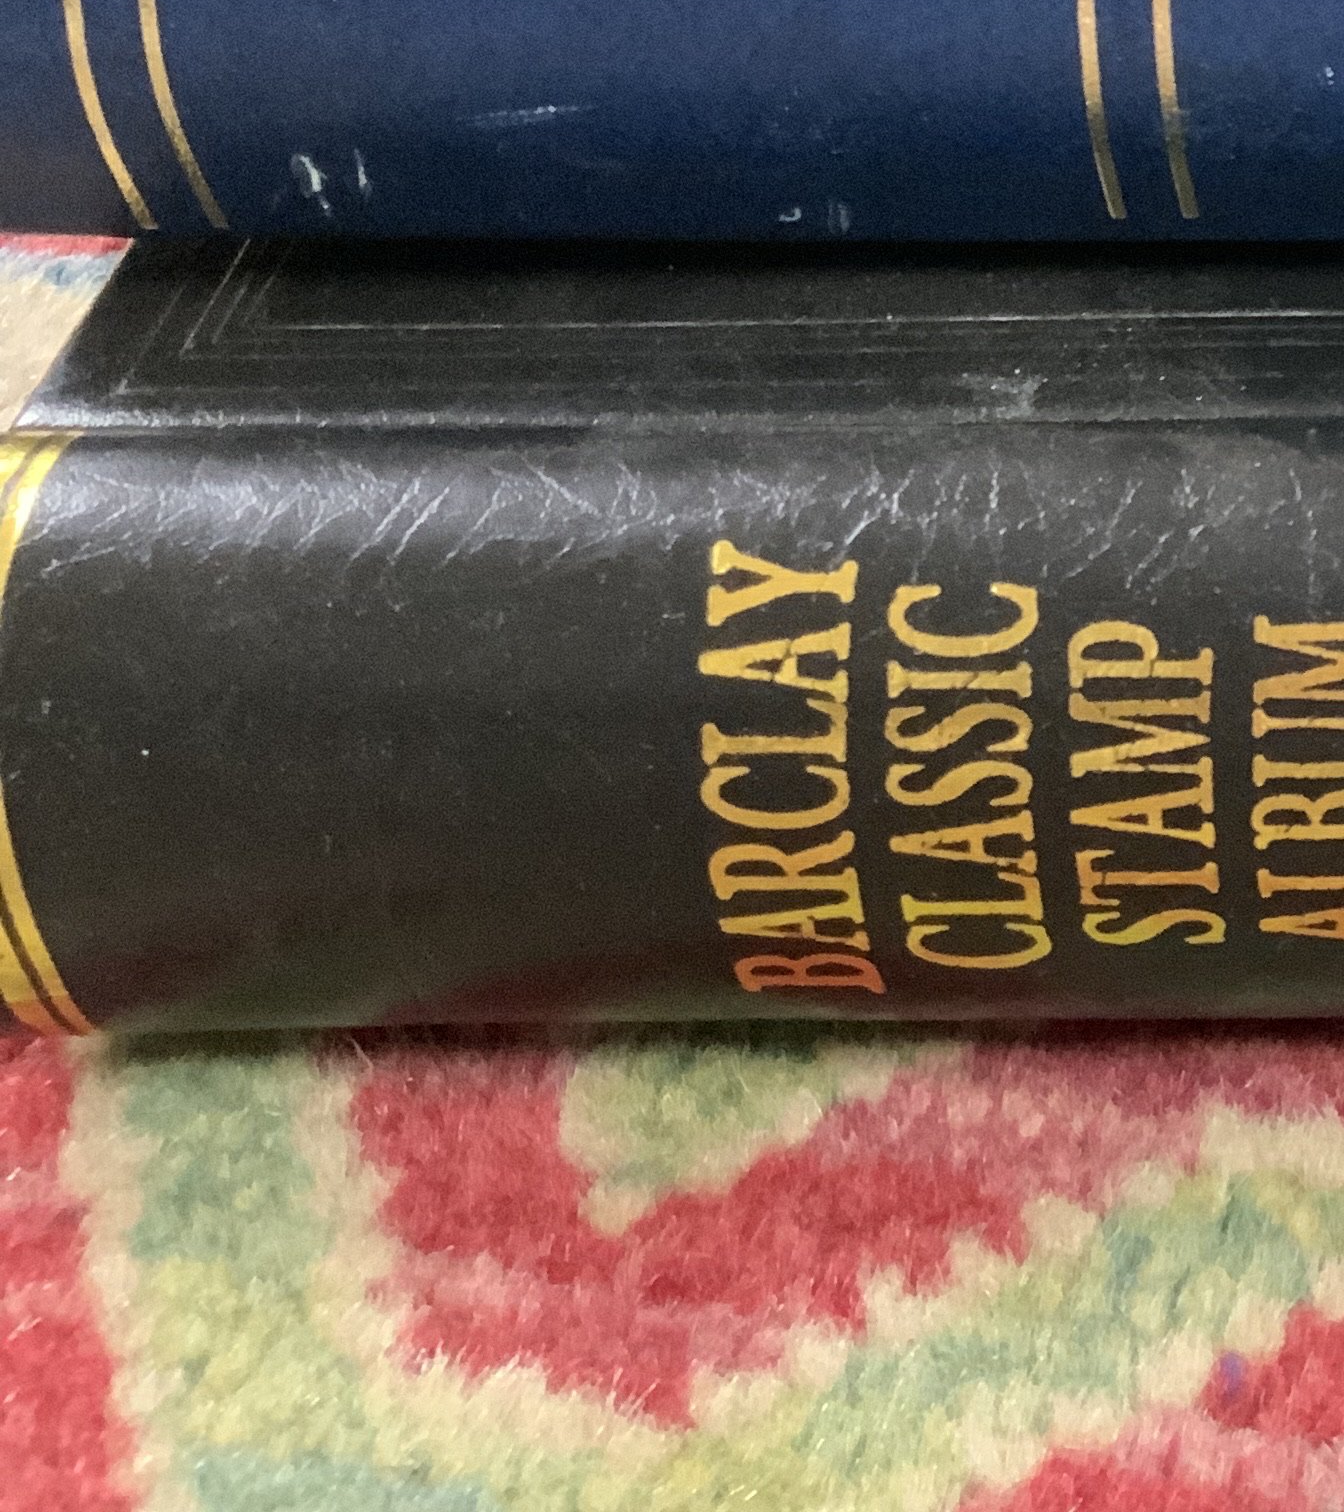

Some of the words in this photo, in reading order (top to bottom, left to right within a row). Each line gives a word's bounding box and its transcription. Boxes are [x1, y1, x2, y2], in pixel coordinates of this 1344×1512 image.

[697, 539, 887, 995] BARCLAY
[885, 582, 1052, 971] CLASSIC
[1067, 619, 1226, 948] STAMP
